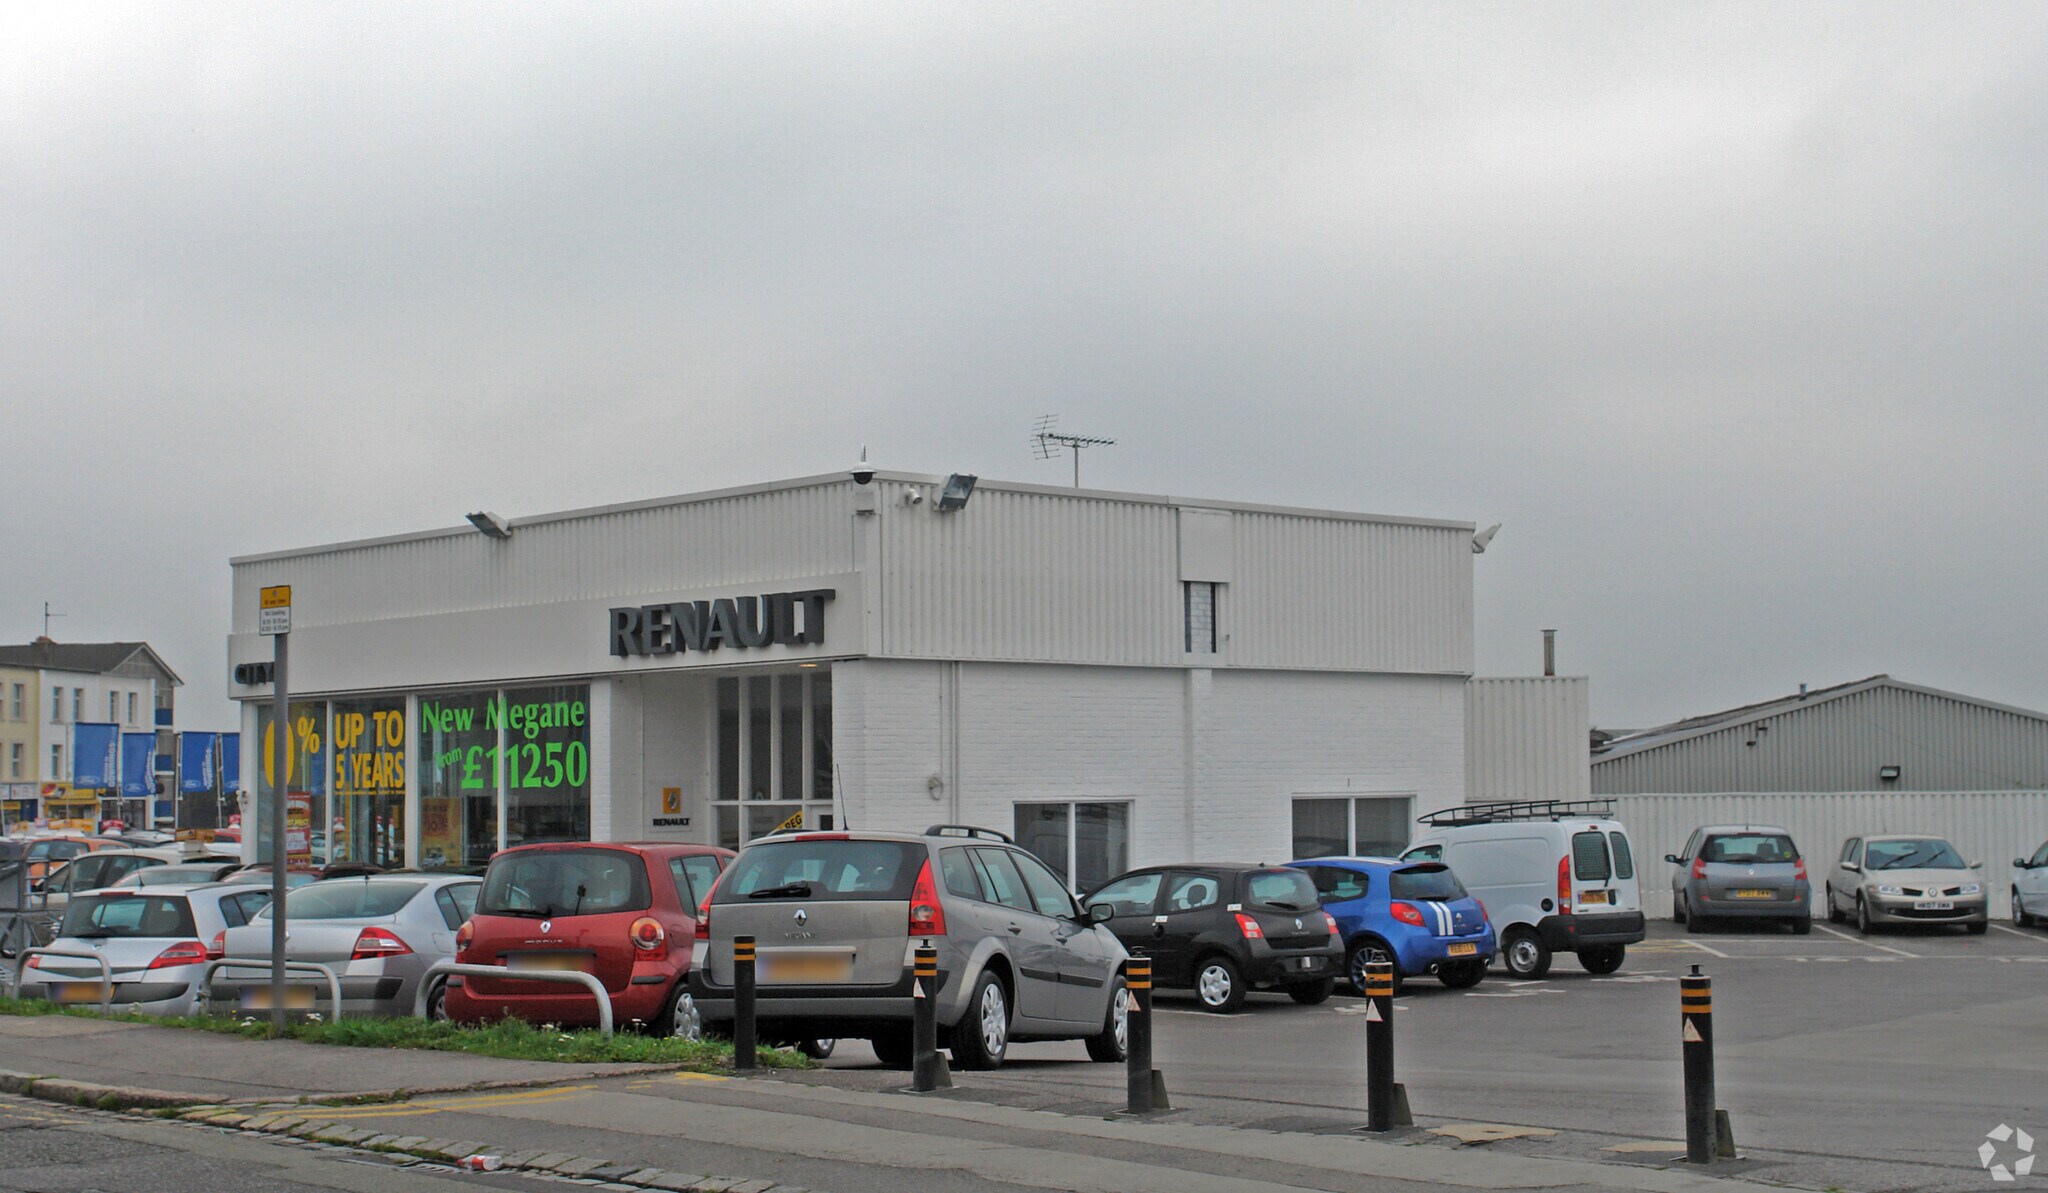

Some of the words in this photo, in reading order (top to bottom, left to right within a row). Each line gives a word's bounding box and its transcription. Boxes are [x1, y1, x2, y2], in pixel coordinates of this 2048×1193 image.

[609, 589, 836, 657] RENAULT
[335, 713, 364, 749] UP
[373, 710, 404, 747] TO
[422, 701, 475, 733] New
[485, 697, 585, 739] Megane
[336, 754, 345, 789] 5
[352, 752, 404, 788] YEARS
[461, 741, 588, 789] £11250
[653, 817, 690, 827] RENAULT
